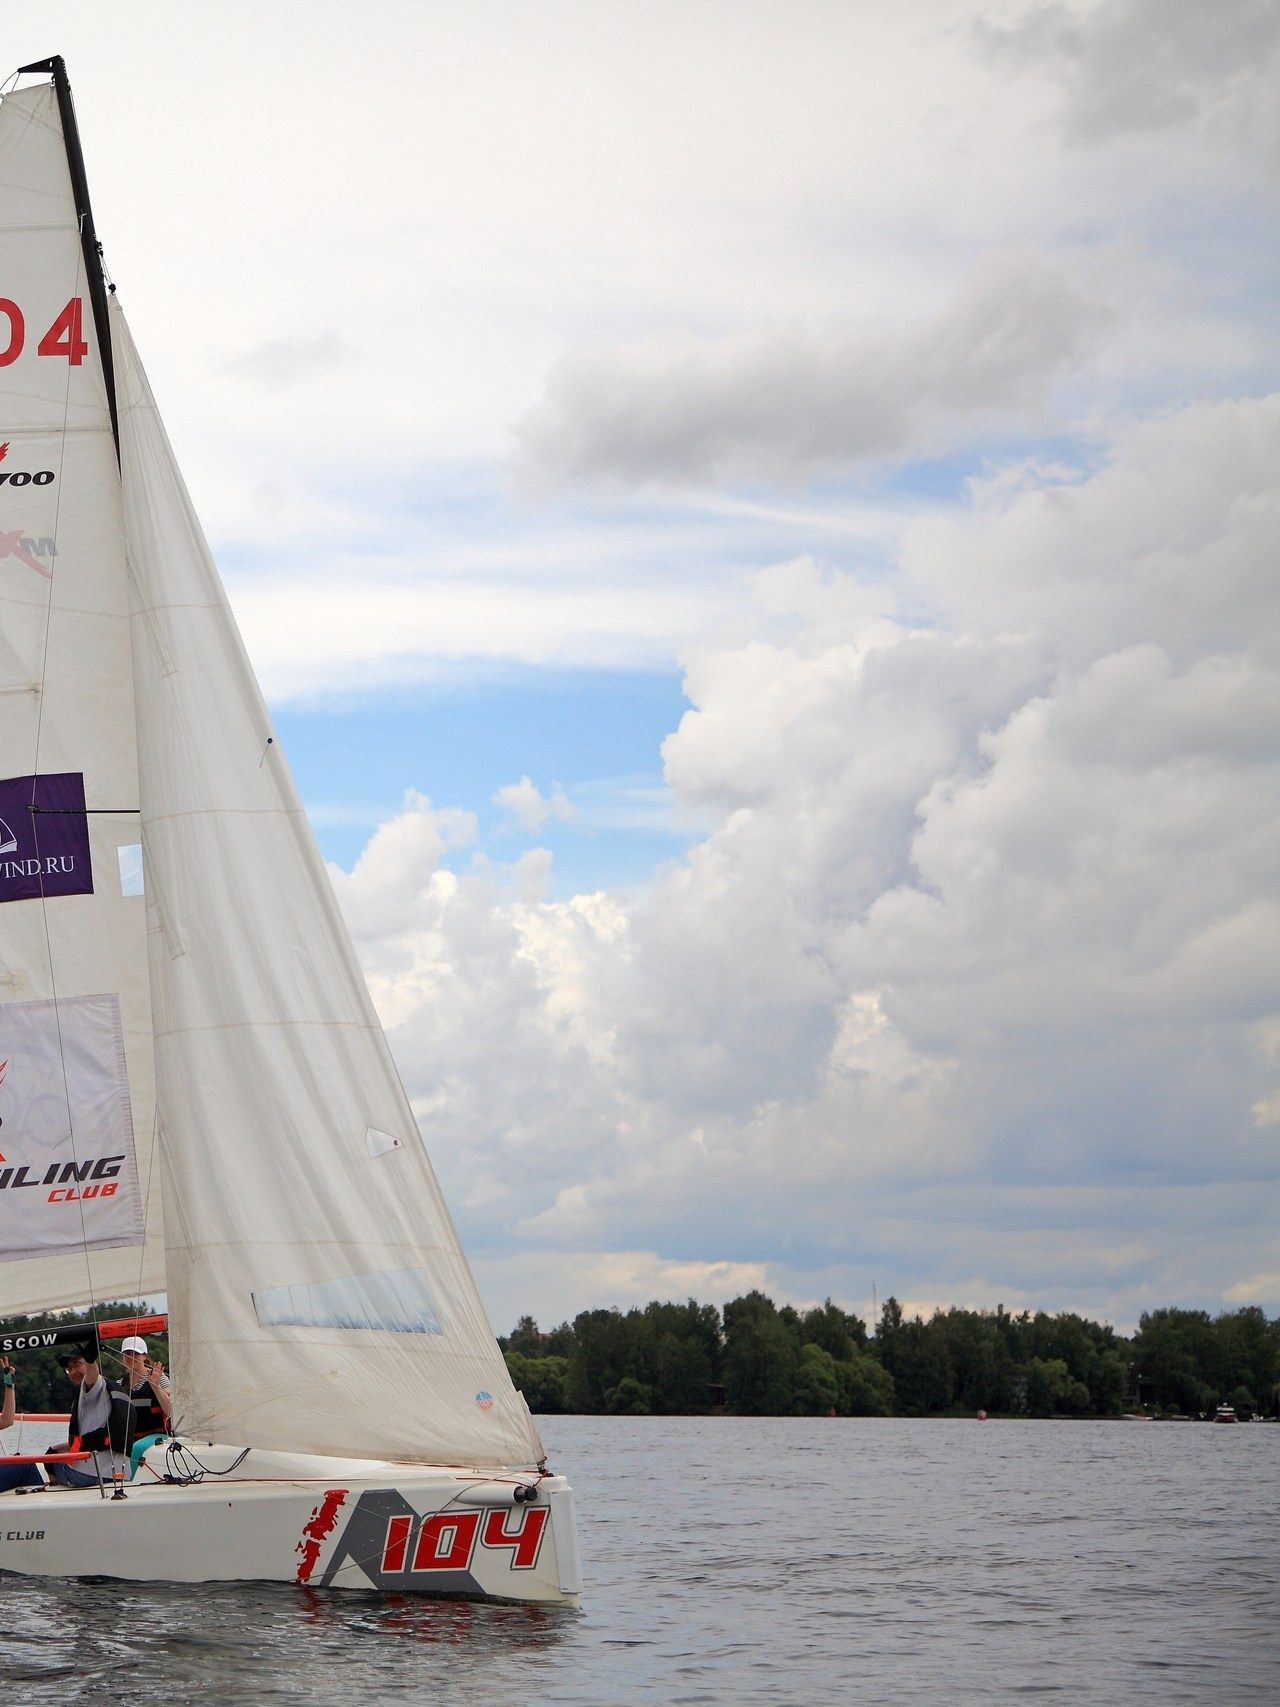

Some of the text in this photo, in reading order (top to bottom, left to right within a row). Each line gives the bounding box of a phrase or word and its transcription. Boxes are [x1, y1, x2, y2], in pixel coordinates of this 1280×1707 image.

[47, 1183, 119, 1203] CLUB
[6, 1530, 46, 1540] CLUB
[380, 1505, 552, 1573] 104
